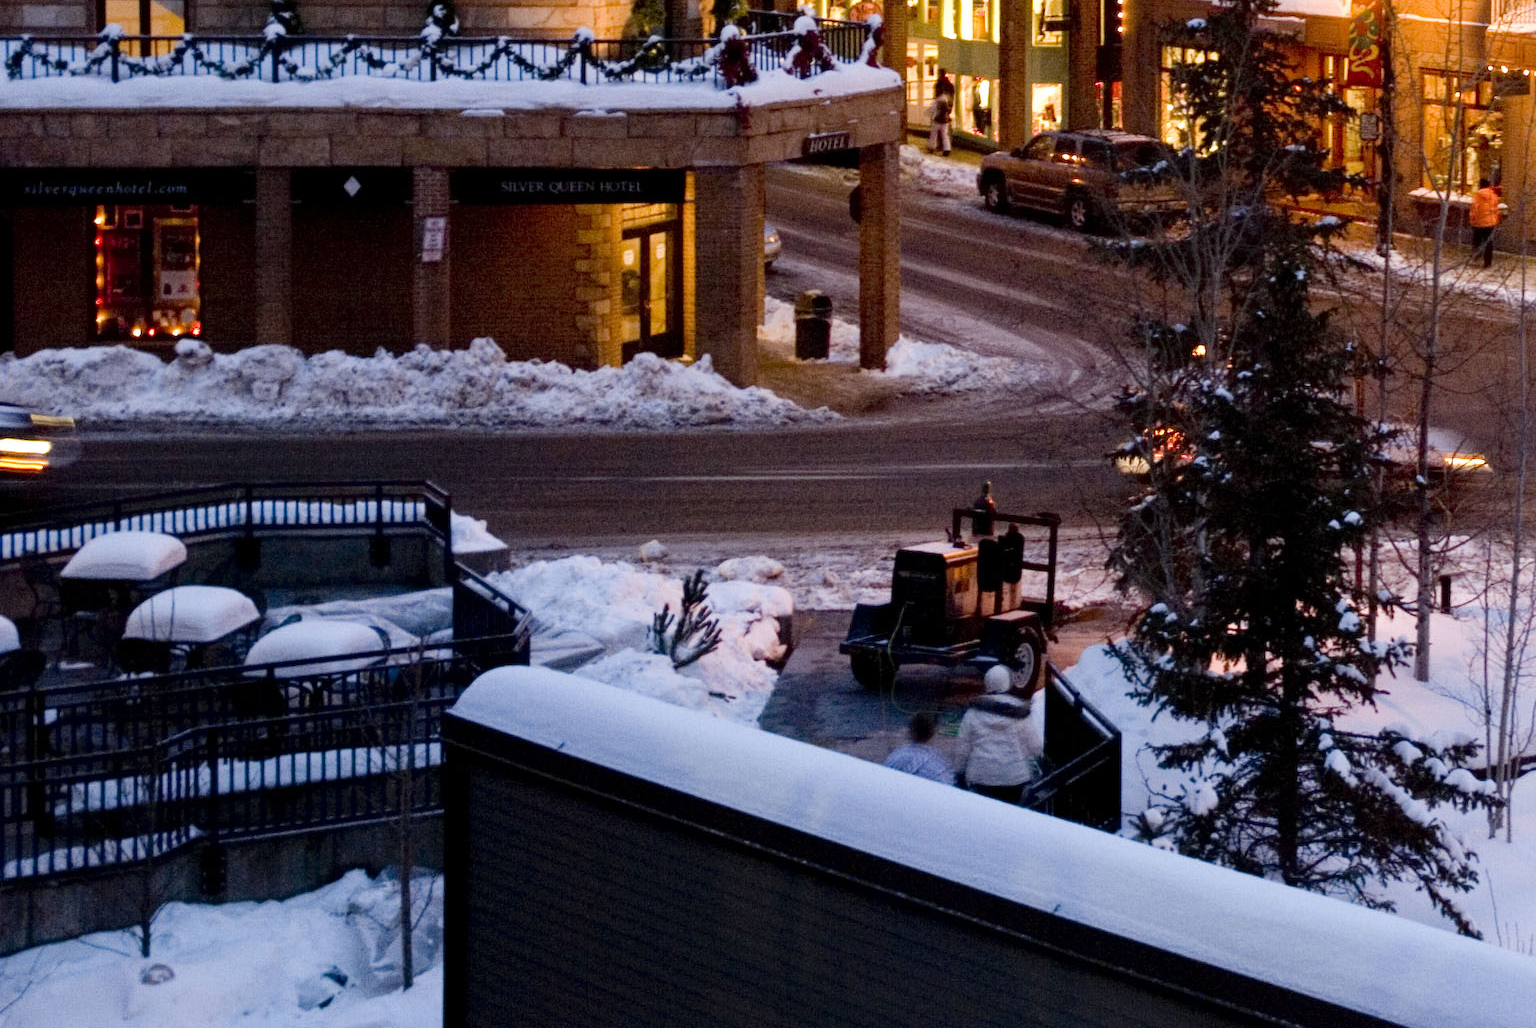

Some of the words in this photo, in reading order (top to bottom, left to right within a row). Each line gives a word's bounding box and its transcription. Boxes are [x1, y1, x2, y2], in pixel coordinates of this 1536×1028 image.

[809, 136, 846, 152] HOTEL
[24, 180, 188, 196] silverqueenhotel.com
[501, 181, 544, 192] SILVER
[549, 181, 595, 194] QUEEN
[600, 181, 642, 193] HOTEL
